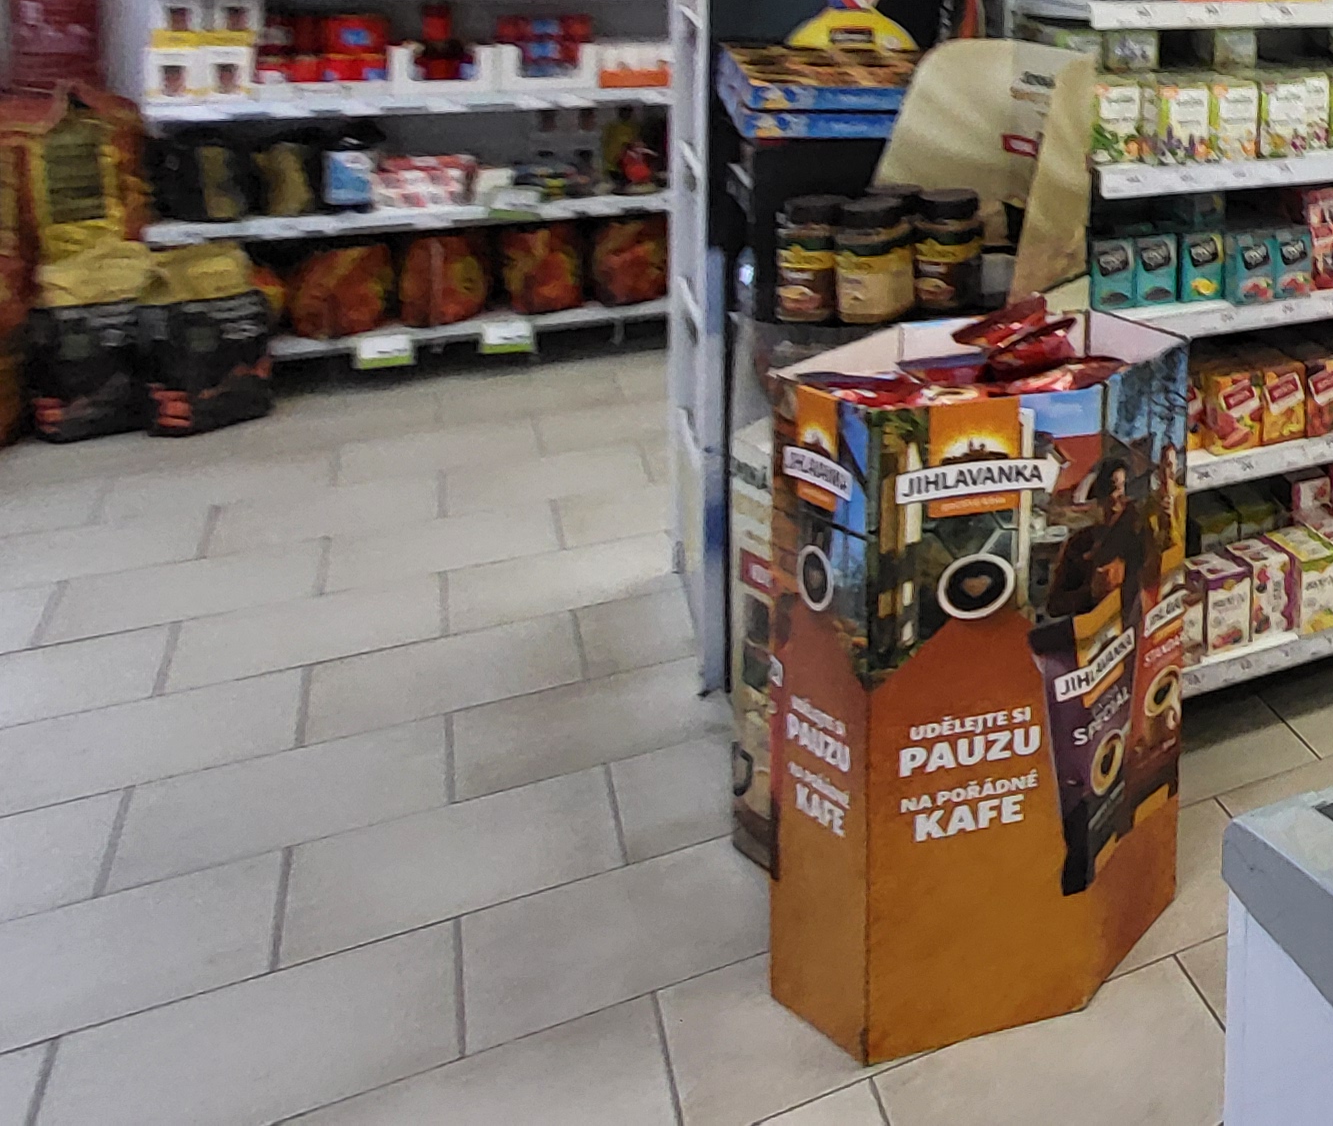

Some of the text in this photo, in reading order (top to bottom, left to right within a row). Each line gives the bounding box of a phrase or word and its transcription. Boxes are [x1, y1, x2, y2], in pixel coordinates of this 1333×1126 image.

[902, 463, 1043, 498] JIHLAVANKA
[909, 706, 1032, 741] UDĚLEJTE SI
[899, 725, 1042, 778] PAUZU
[900, 768, 1039, 814] NA POŘÁDNÉ
[913, 794, 1026, 844] KAFE
